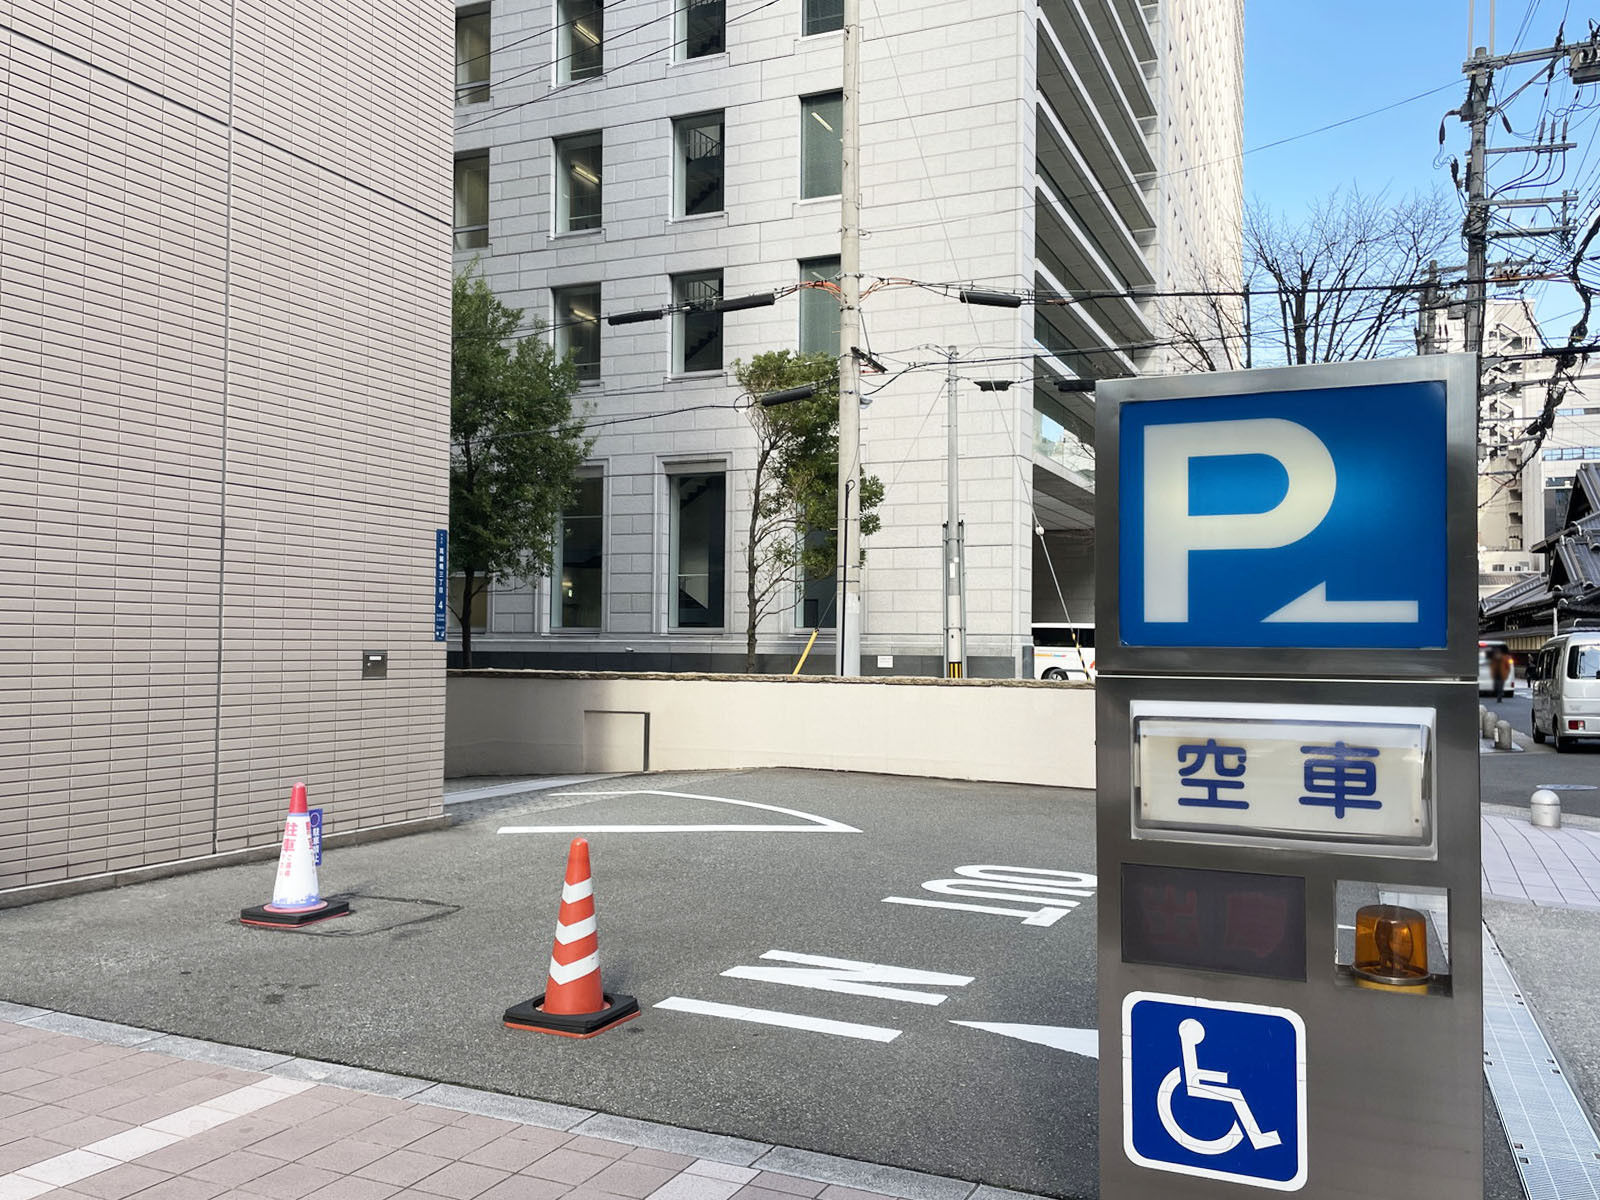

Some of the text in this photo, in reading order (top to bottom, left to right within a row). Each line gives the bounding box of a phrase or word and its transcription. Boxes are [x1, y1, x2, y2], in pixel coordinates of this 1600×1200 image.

[1143, 417, 1337, 623] P
[1177, 738, 1383, 819] 空車
[281, 822, 298, 852] 駐車
[880, 864, 1098, 927] OUT
[1143, 882, 1289, 960] 出
[652, 949, 976, 1043] IN
